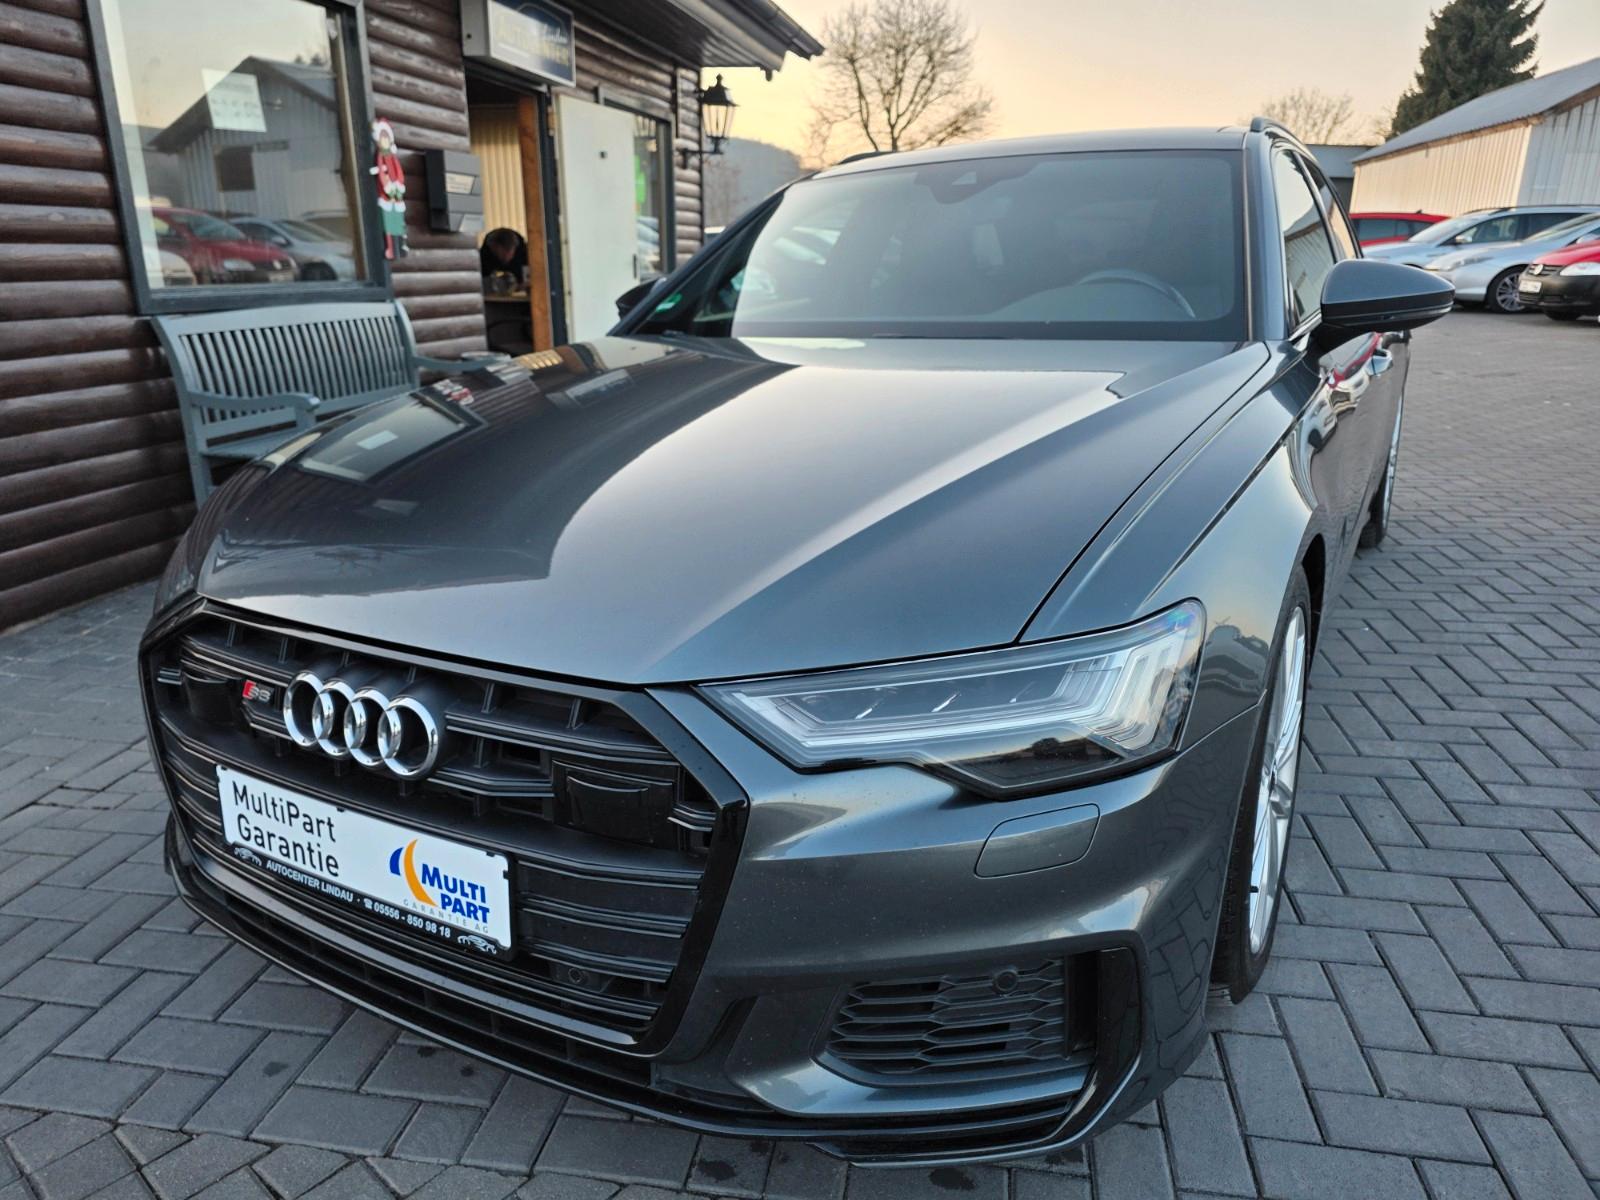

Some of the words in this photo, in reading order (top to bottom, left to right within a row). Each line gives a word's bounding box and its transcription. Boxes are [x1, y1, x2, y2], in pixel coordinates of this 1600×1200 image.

[232, 780, 337, 843] MultiPart
[237, 813, 340, 877] Garantie
[266, 860, 320, 889] AUTOCENTER
[321, 881, 354, 902] LINDAU
[373, 901, 400, 920] 05556
[406, 914, 424, 929] 850
[425, 921, 438, 934] 98
[439, 926, 451, 938] 18
[421, 863, 487, 904] MULTI
[440, 892, 491, 924] PART
[403, 898, 468, 926] GARANTIE
[474, 923, 490, 935] AG
